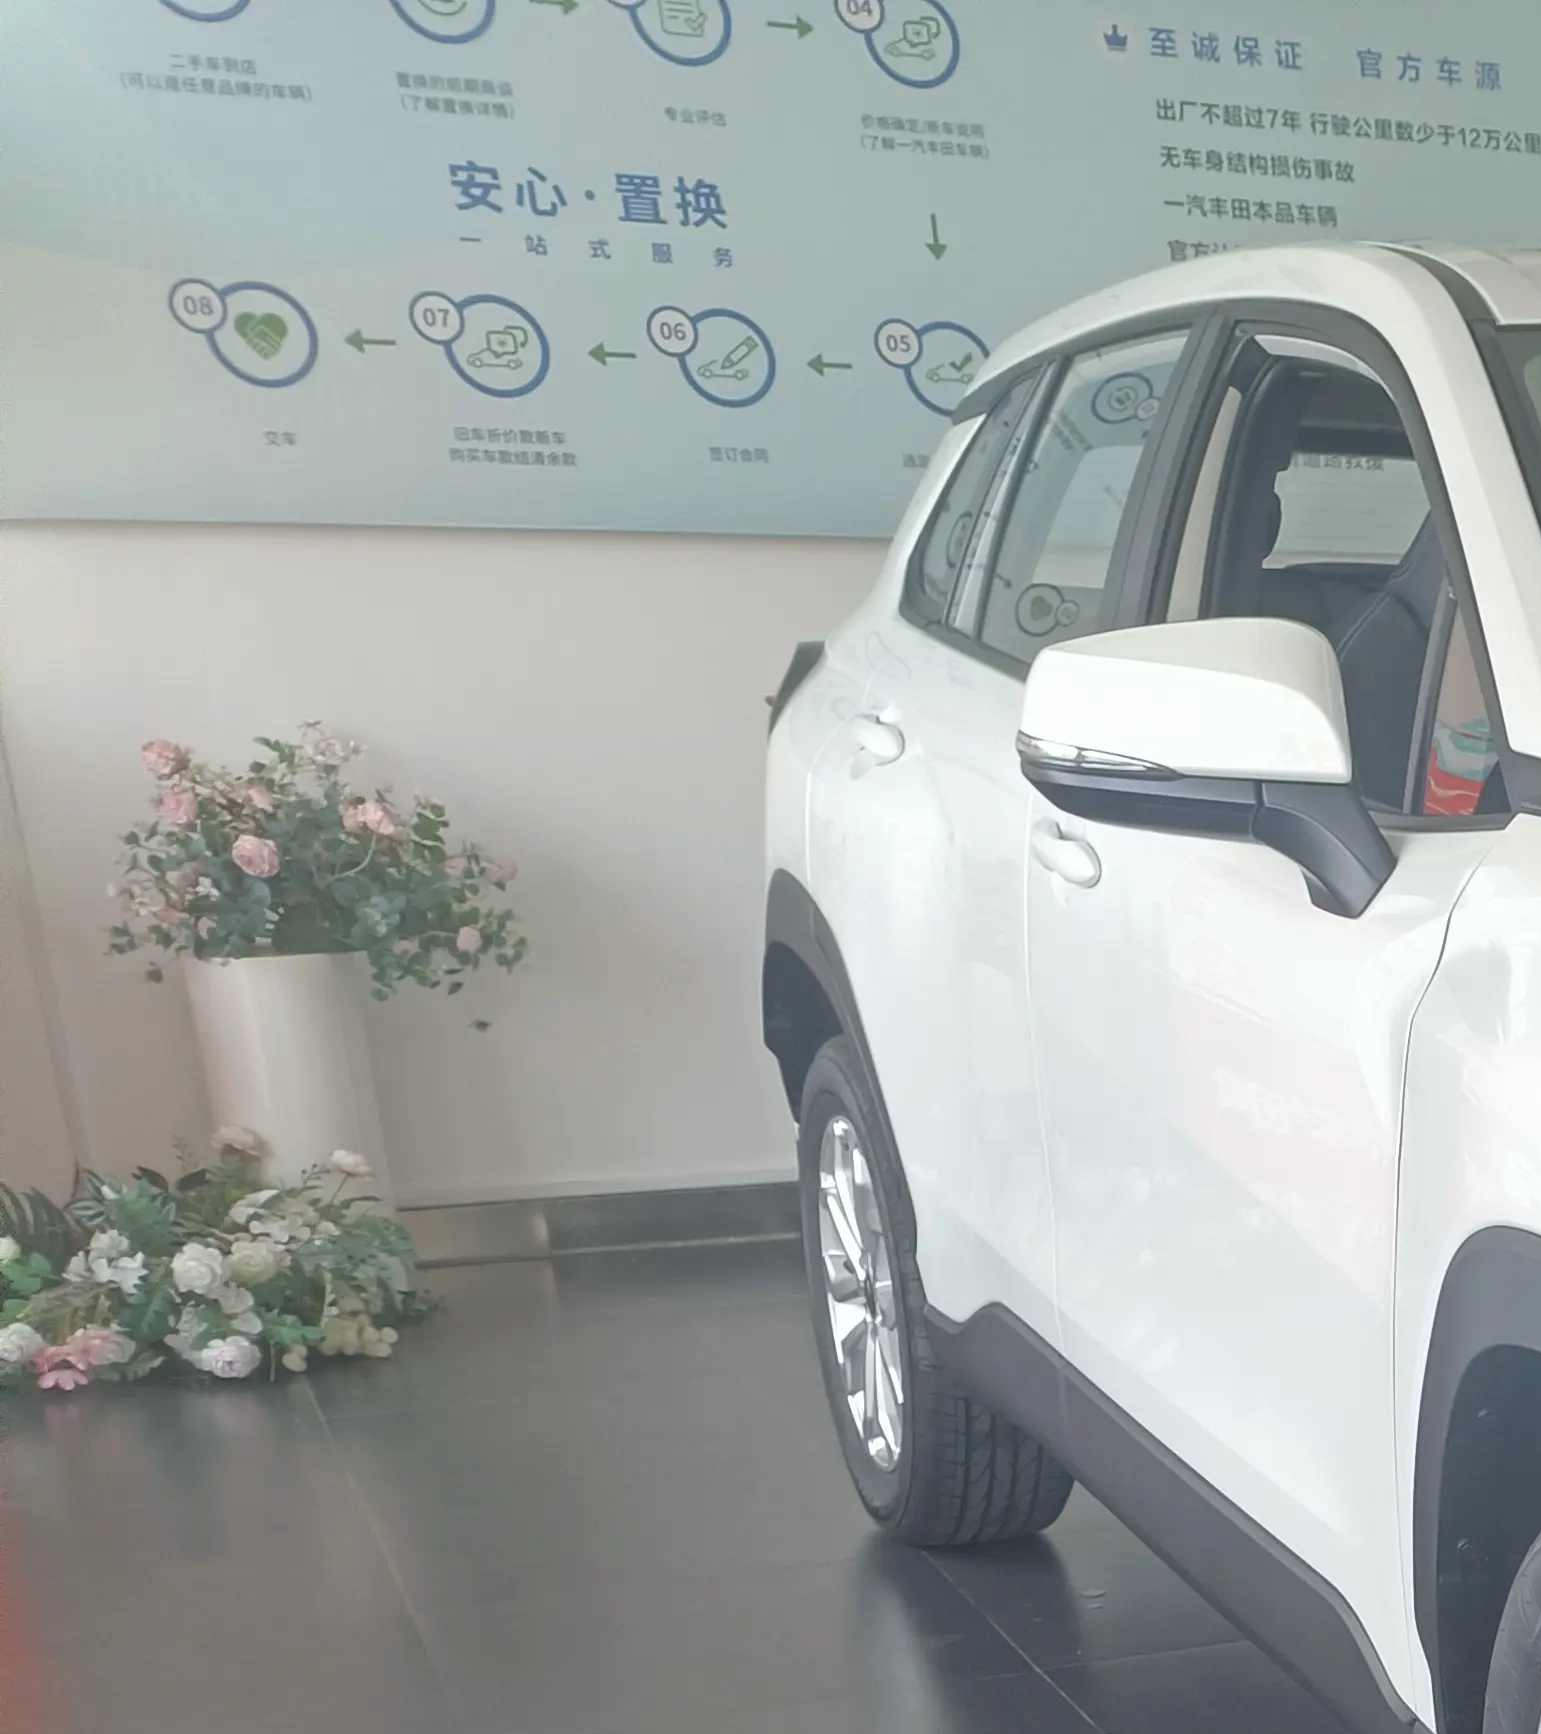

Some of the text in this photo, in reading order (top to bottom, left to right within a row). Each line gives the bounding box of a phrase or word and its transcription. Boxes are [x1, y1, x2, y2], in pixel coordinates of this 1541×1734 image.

[1148, 27, 1502, 91] 至诚保证 官方车源
[1156, 98, 1302, 133] 出厂不超过7年
[1160, 145, 1356, 183] 无车身结构损伤事故
[1163, 194, 1338, 228] 一汽丰田本品车辆
[182, 296, 215, 316] 08
[422, 307, 450, 328] 07
[659, 322, 687, 341] 06
[885, 334, 911, 353] 05
